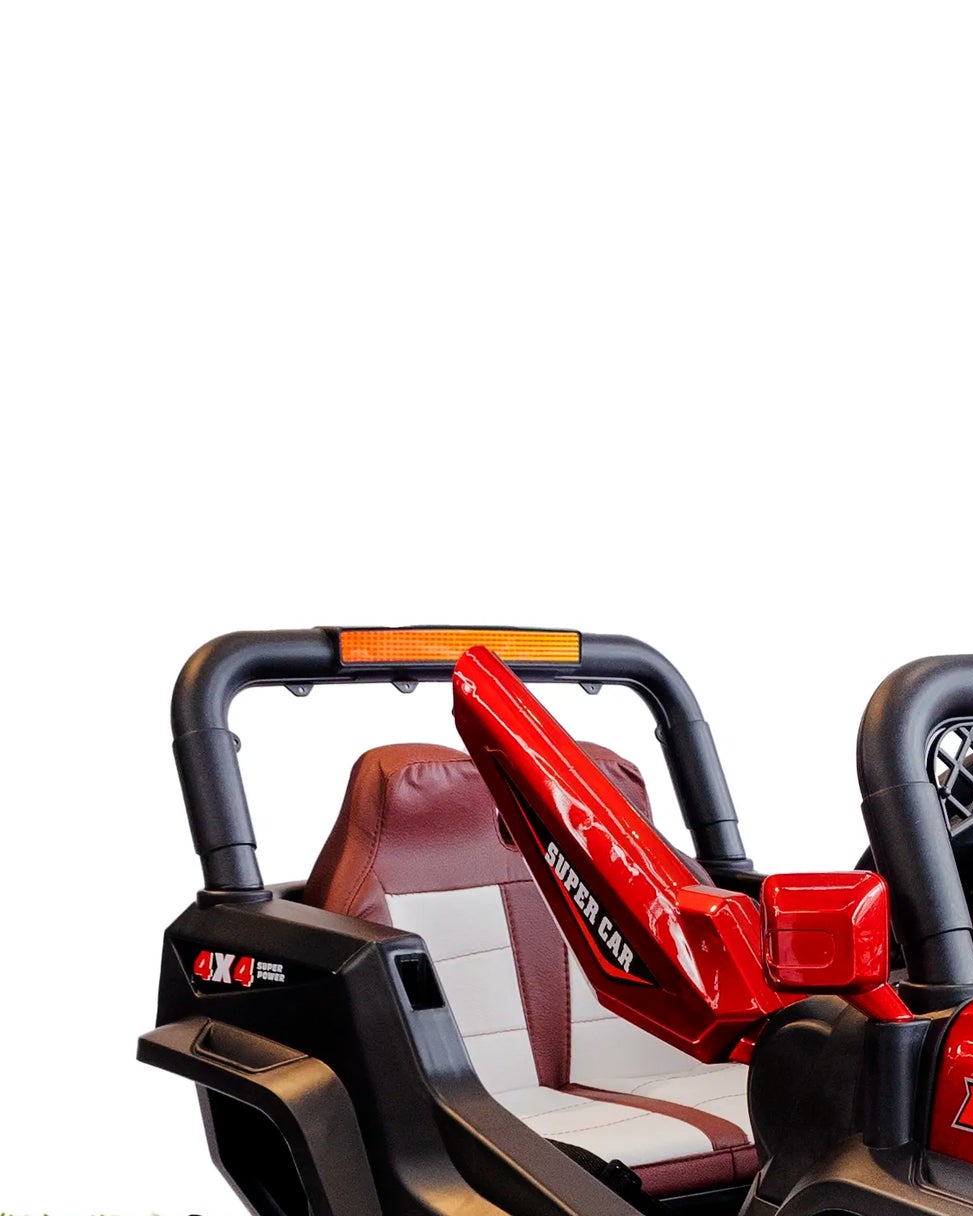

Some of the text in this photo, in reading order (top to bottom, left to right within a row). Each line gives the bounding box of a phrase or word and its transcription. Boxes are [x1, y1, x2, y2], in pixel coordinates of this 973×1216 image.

[544, 841, 634, 973] SUPER CAR
[193, 950, 255, 987] 4X4
[256, 961, 284, 974] SUPER
[256, 970, 286, 983] POWER
